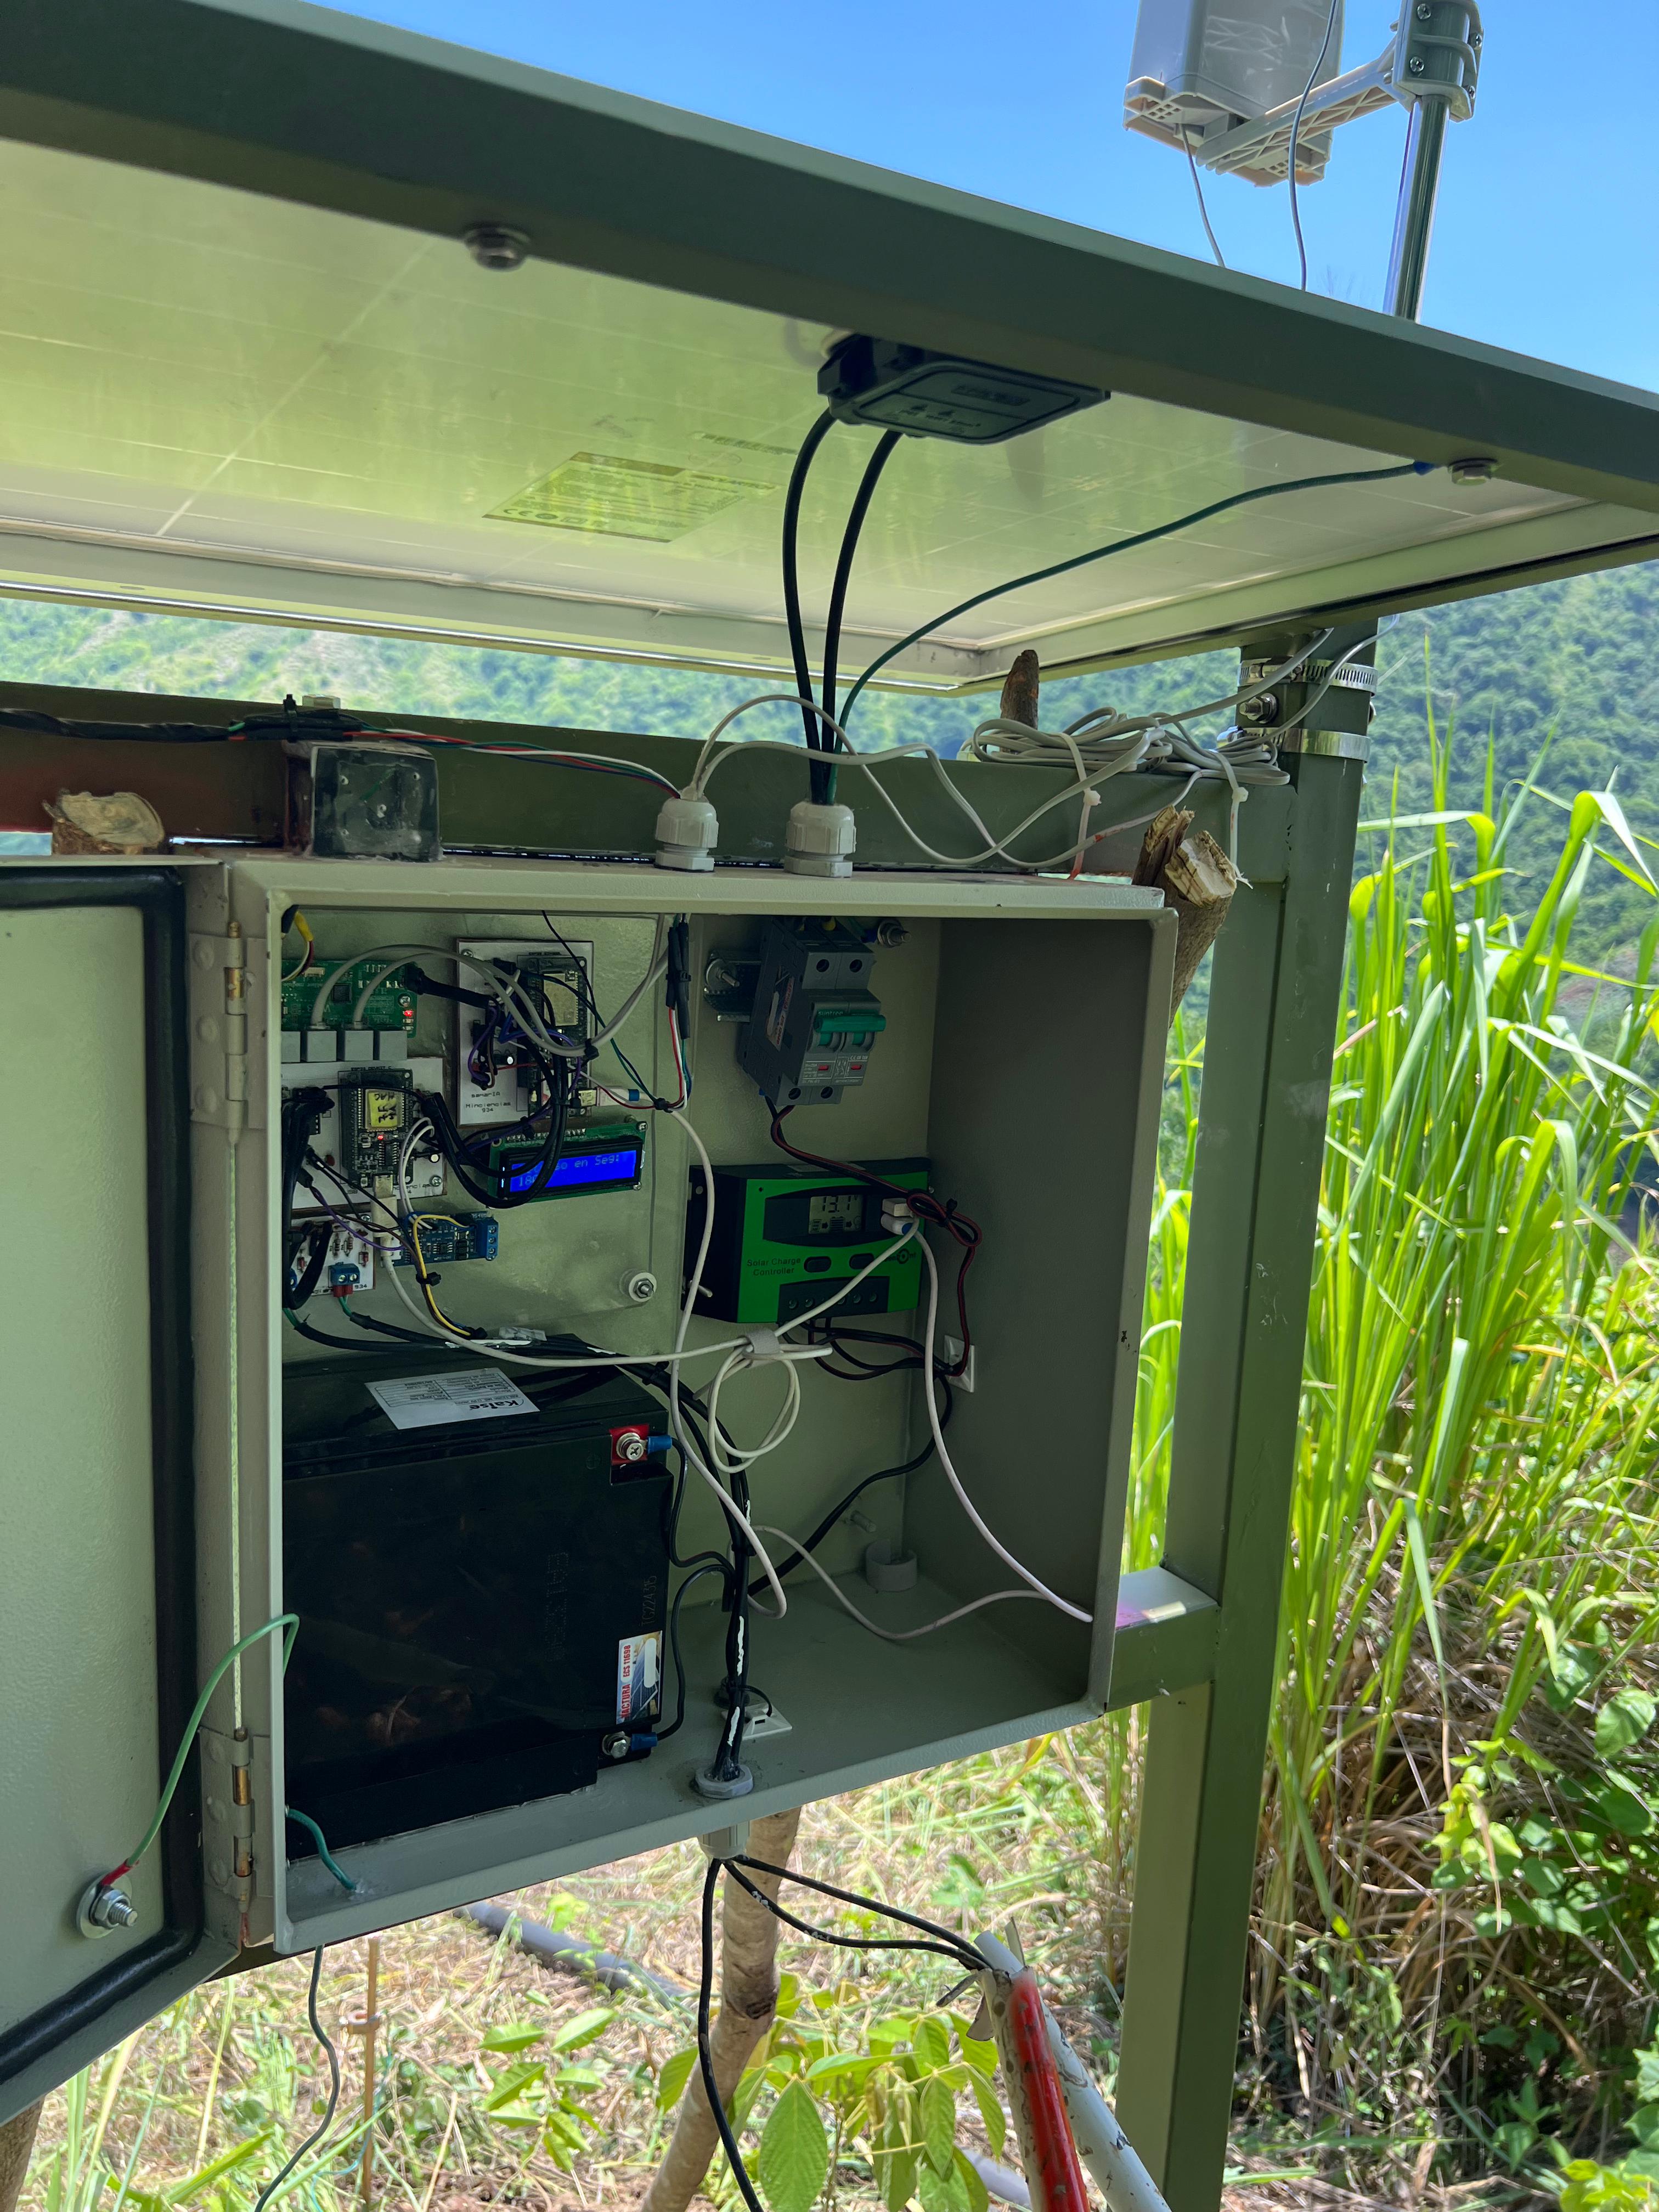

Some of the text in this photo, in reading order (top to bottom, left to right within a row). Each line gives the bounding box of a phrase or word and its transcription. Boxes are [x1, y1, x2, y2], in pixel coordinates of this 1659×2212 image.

[574, 1160, 588, 1168] en
[771, 1257, 801, 1266] Charge
[753, 1267, 795, 1276] Controller
[469, 1400, 519, 1410] Kaise
[623, 1645, 631, 1665] 11698
[622, 1666, 630, 1678] ECS
